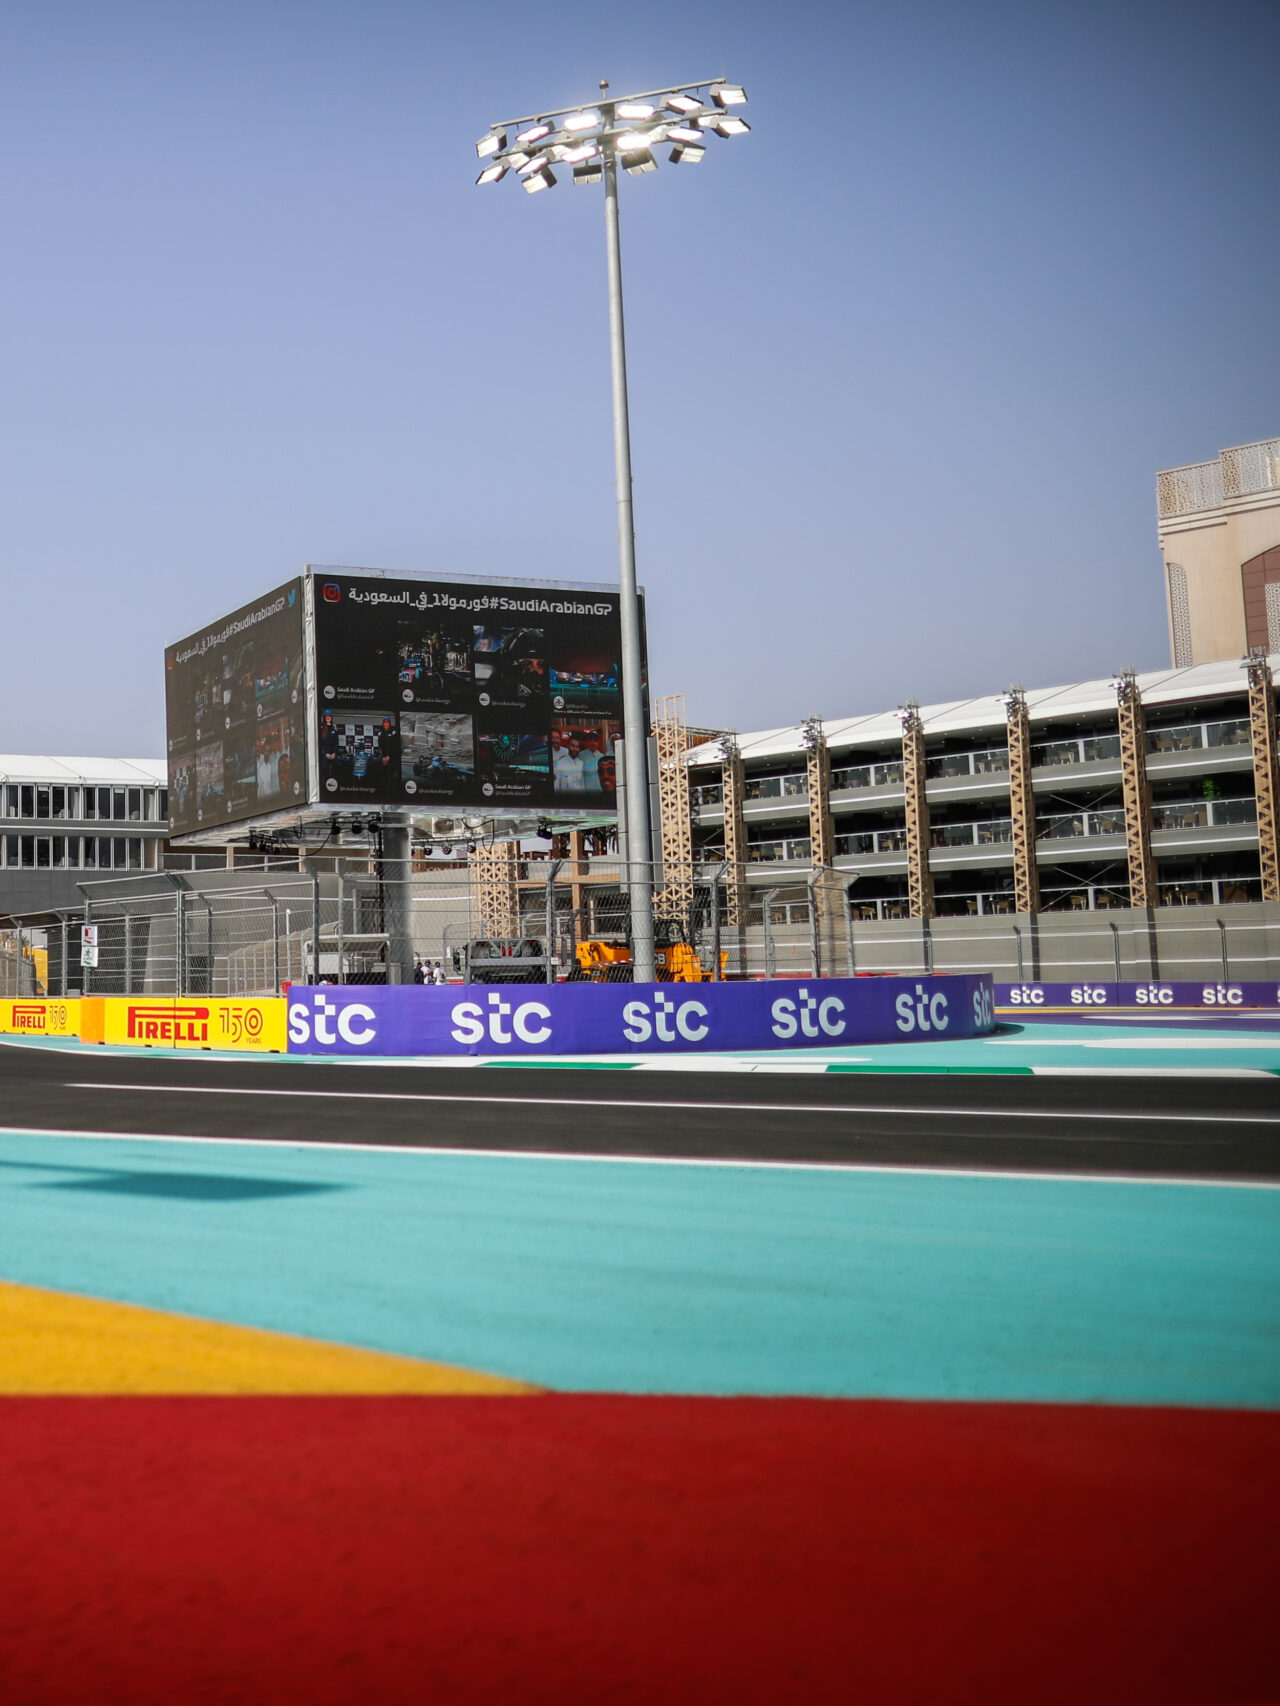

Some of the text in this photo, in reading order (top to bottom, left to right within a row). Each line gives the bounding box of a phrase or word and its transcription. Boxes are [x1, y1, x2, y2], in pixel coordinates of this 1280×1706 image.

[895, 984, 949, 1032] stc
[1010, 986, 1044, 1004] stc
[1070, 986, 1107, 1004] stc
[1135, 985, 1174, 1004] stc
[1202, 985, 1244, 1004] stc
[12, 1005, 67, 1030] PIRELLI 150
[127, 1006, 263, 1043] PIRELLI 150
[288, 993, 376, 1045] stc
[451, 992, 552, 1044] stc
[623, 991, 709, 1042] stc
[771, 988, 846, 1039] stc
